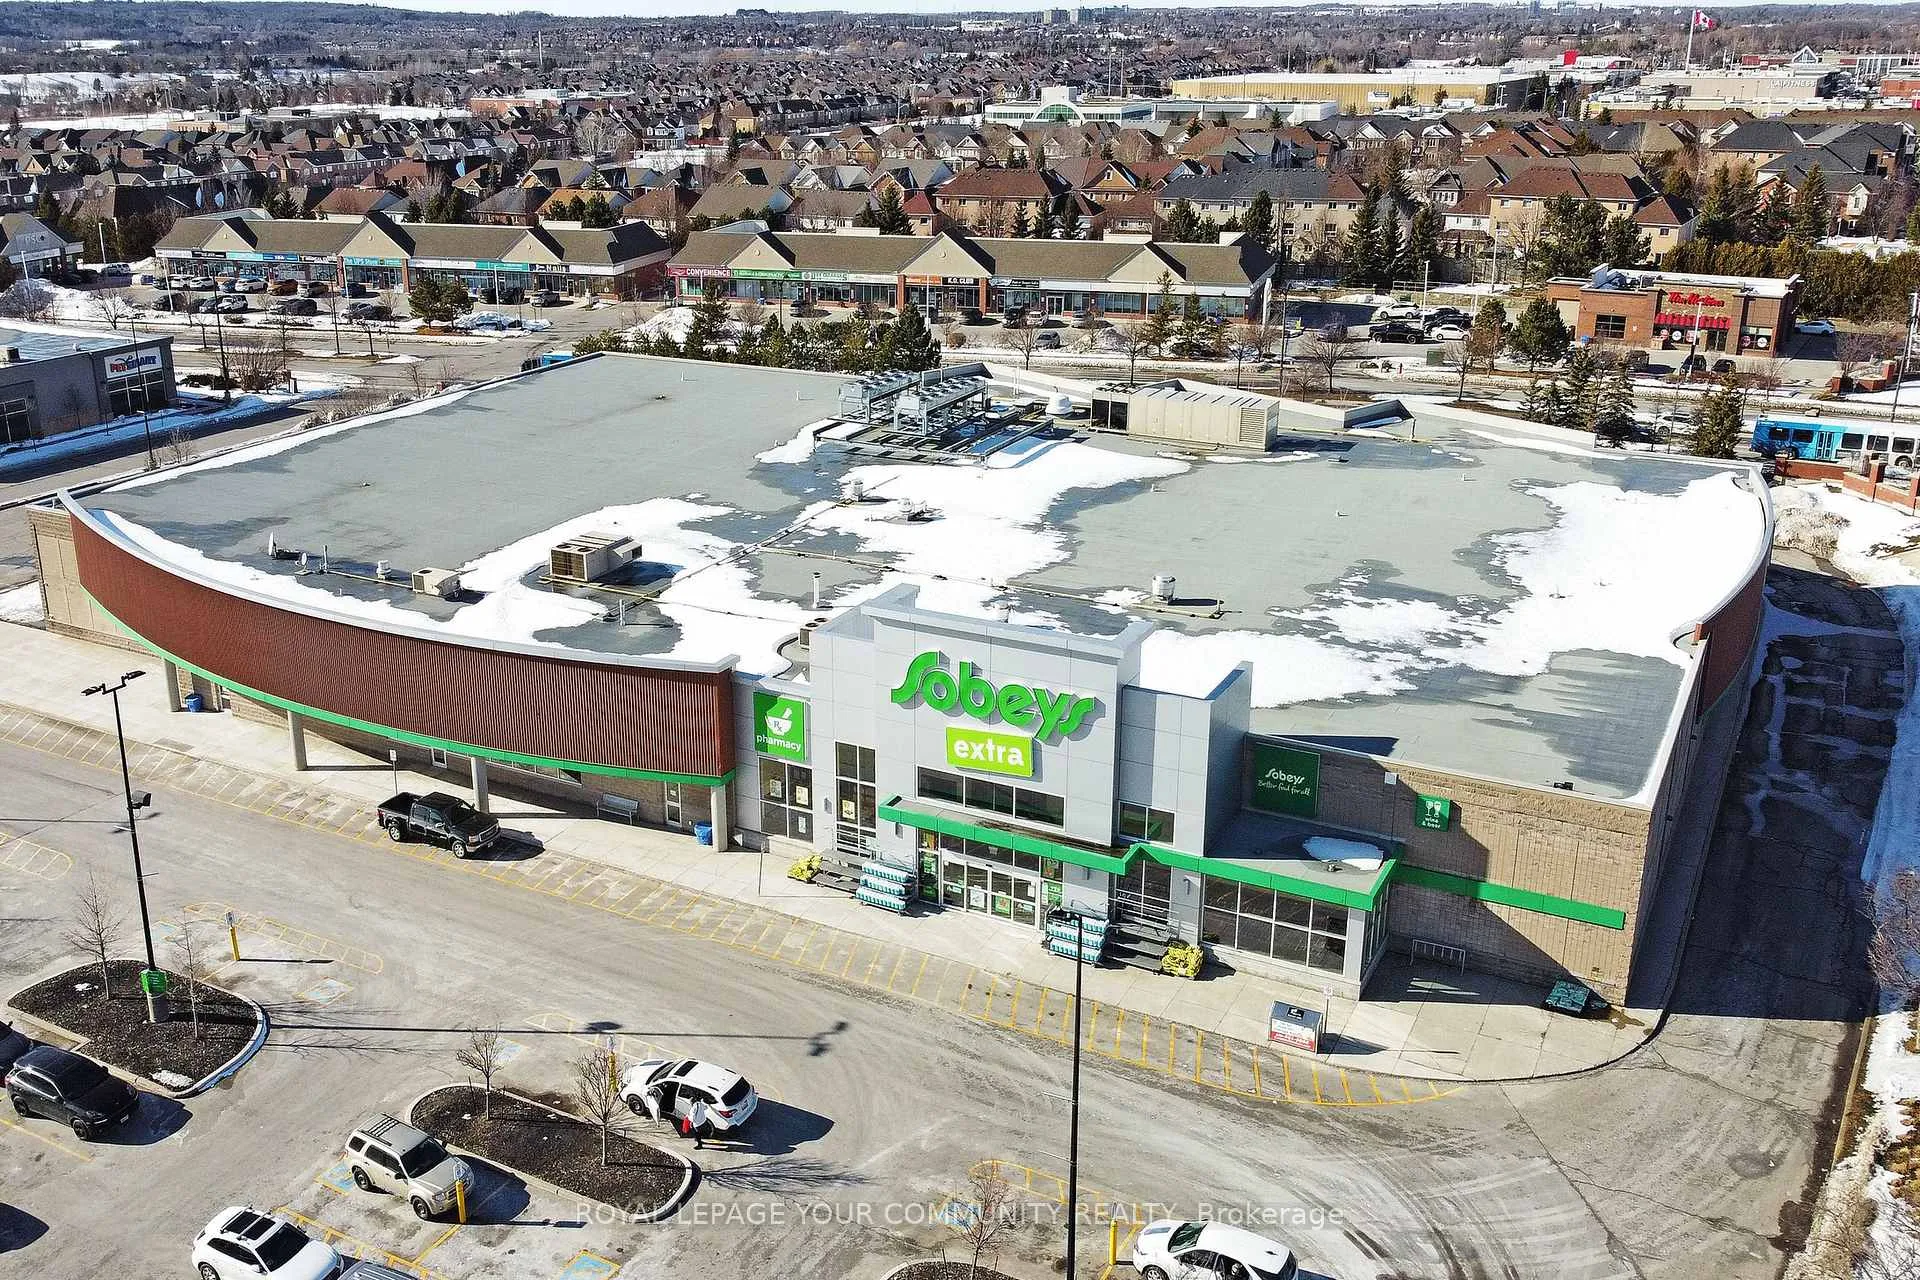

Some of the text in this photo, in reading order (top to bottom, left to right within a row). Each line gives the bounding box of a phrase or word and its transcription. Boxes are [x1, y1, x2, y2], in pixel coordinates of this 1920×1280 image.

[687, 268, 731, 277] CONVENIENCE
[890, 650, 1096, 742] Sobeys
[756, 734, 801, 753] pharmacy
[953, 738, 1025, 767] extra
[1265, 768, 1305, 785] Sobeys
[1427, 820, 1441, 829] beer
